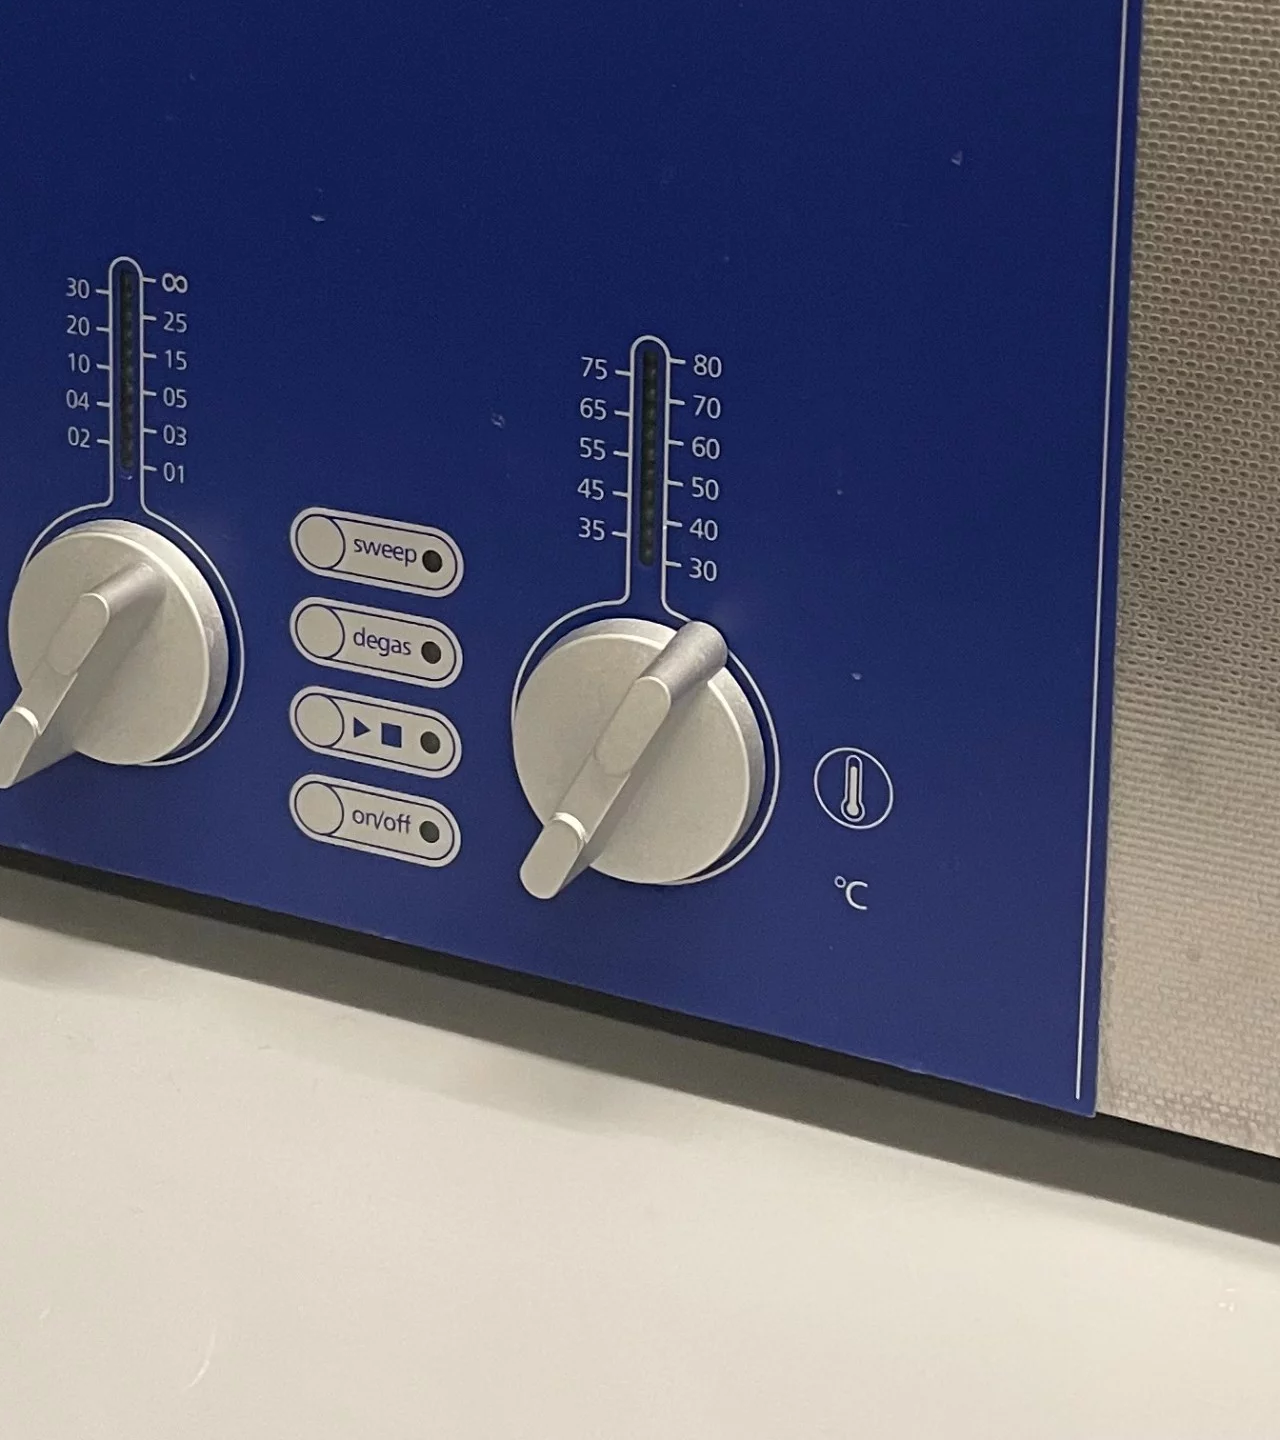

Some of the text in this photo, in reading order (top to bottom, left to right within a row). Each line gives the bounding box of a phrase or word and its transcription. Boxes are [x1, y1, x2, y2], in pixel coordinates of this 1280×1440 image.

[67, 278, 89, 298] 30
[67, 315, 90, 336] 20
[163, 312, 187, 333] 25
[69, 353, 90, 373] 10
[165, 350, 187, 370] 15
[581, 357, 608, 379] 75
[693, 354, 722, 378] 80
[67, 390, 90, 411] 04
[163, 387, 187, 408] 05
[693, 395, 721, 418] 70
[580, 398, 607, 420] 65
[68, 427, 91, 448] 02
[163, 425, 187, 446] 03
[580, 438, 606, 460] 55
[692, 436, 720, 460] 60
[163, 462, 184, 483] 01
[578, 479, 605, 500] 45
[692, 477, 719, 500] 50
[579, 518, 605, 540] 35
[689, 518, 718, 541] 40
[353, 535, 418, 566] sweep
[689, 558, 717, 581] 30
[353, 626, 412, 657] degas
[352, 808, 411, 835] on/off
